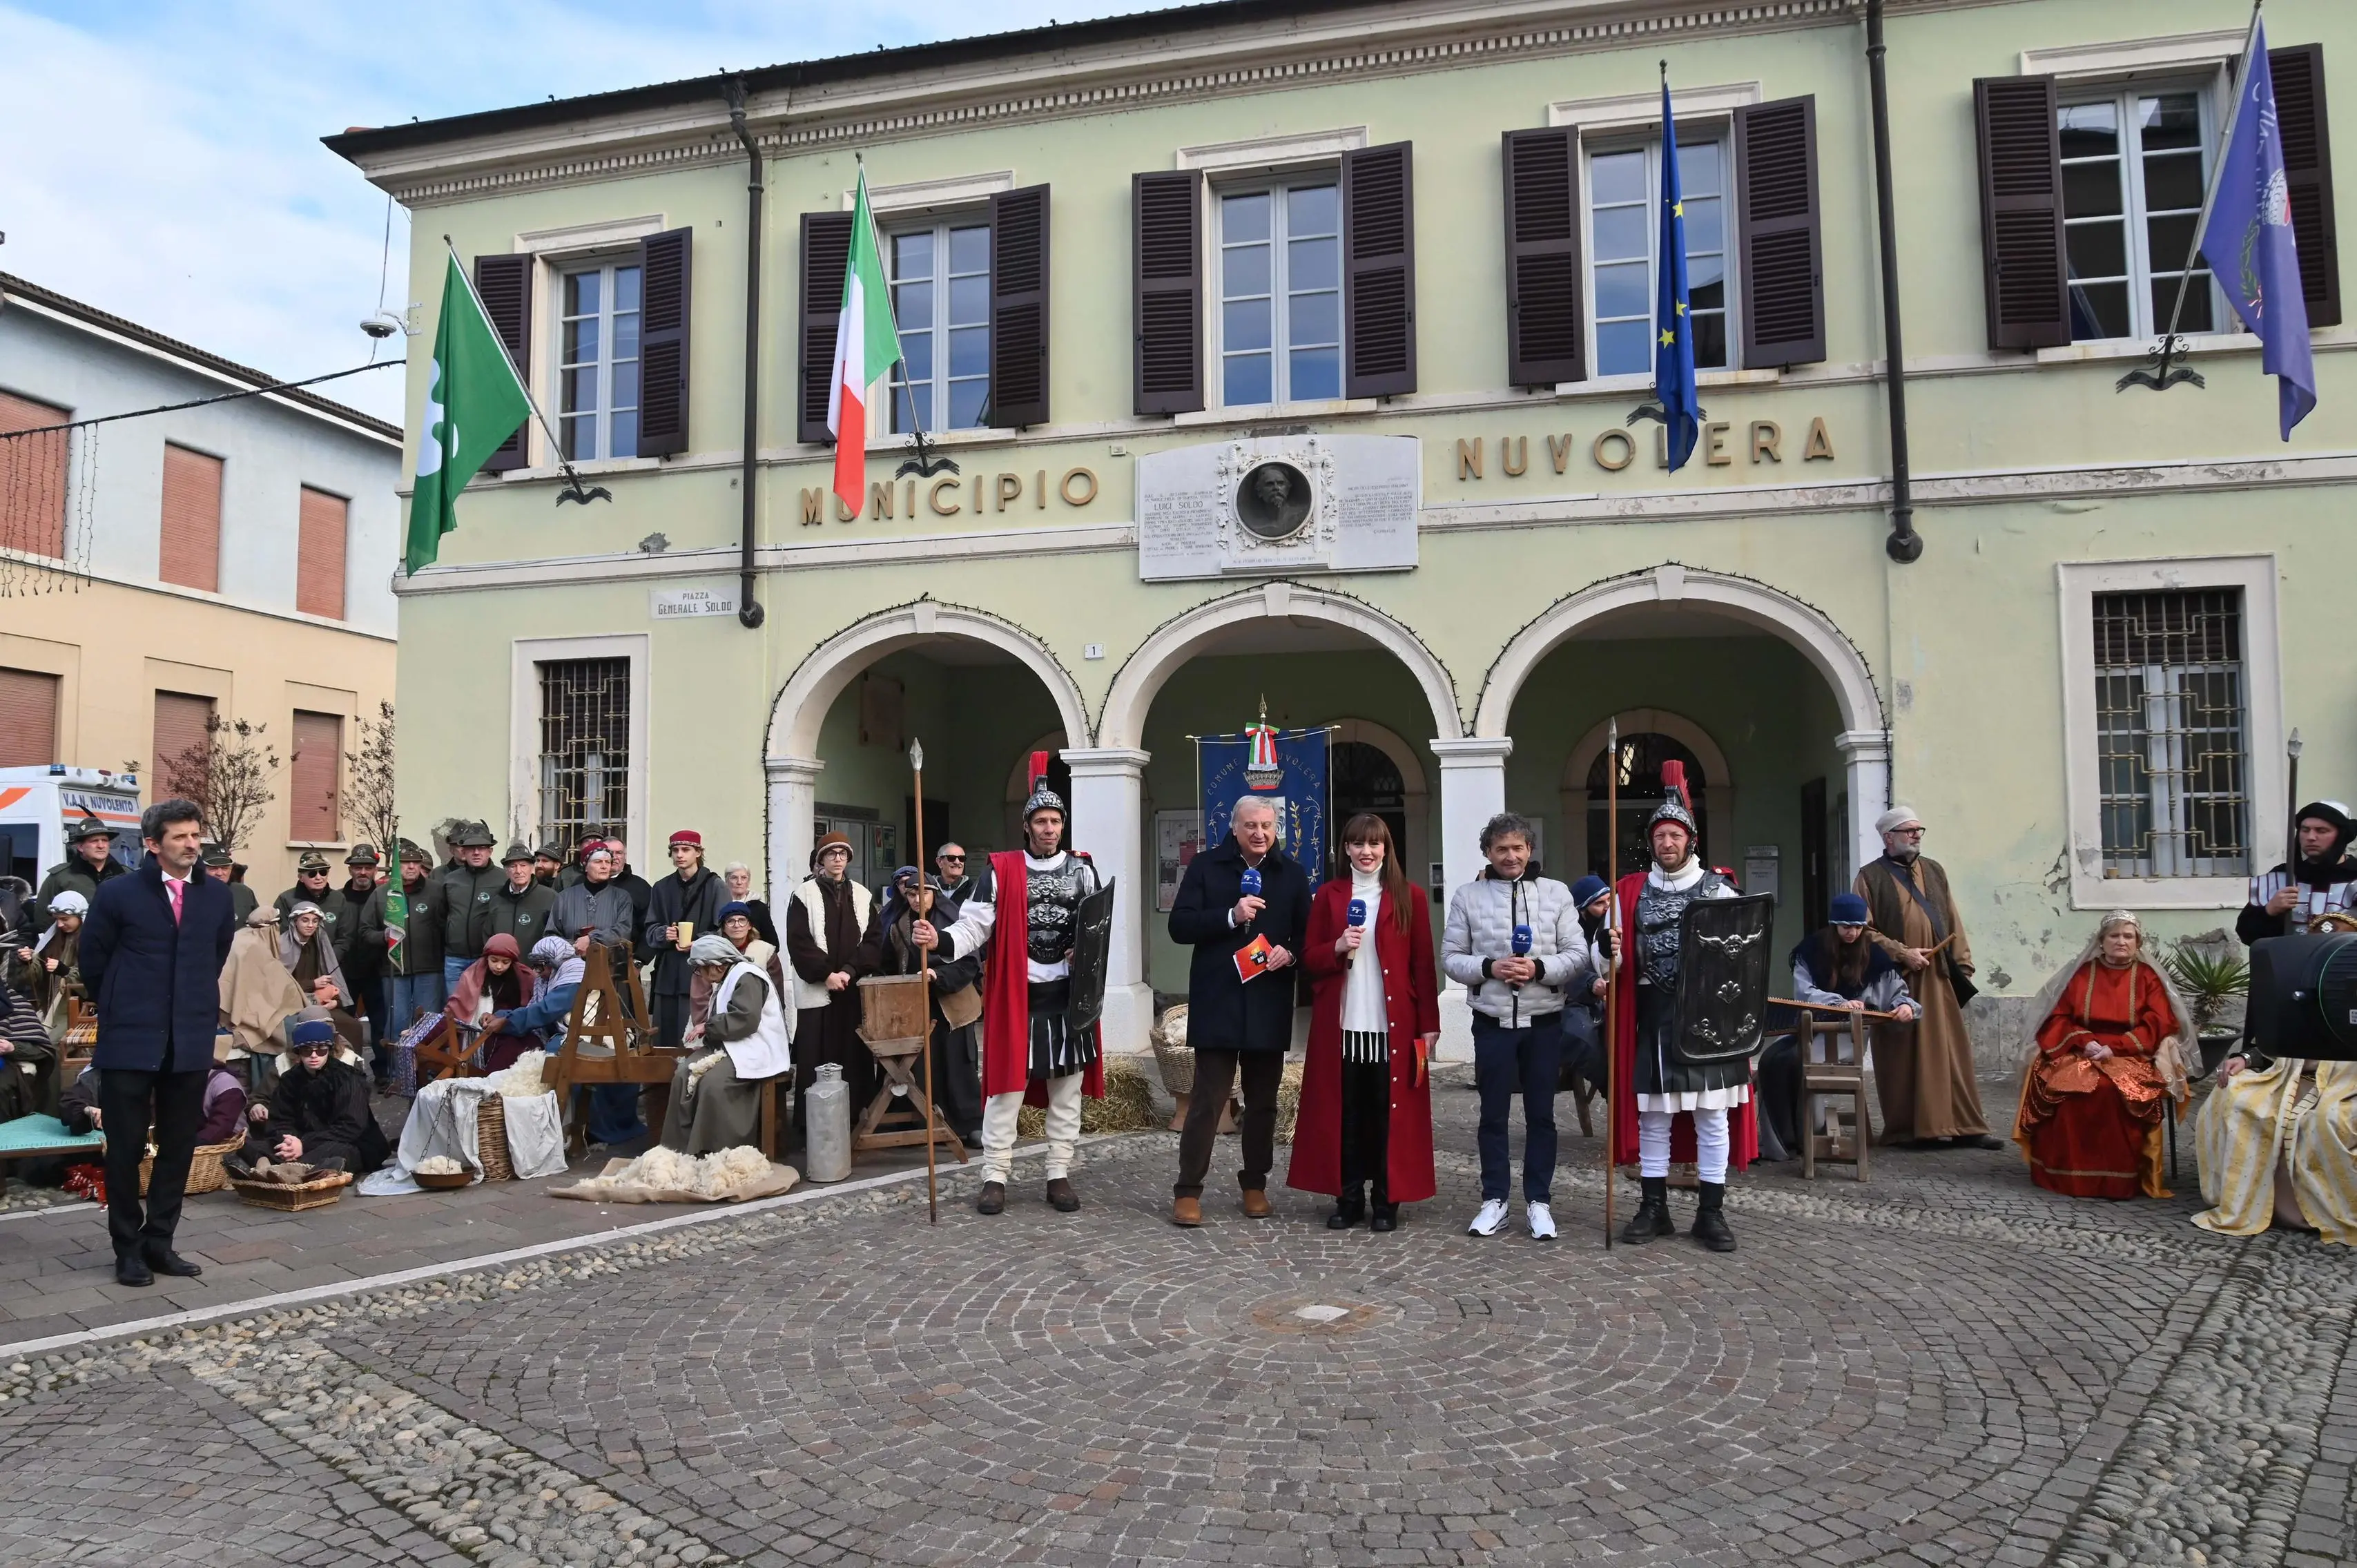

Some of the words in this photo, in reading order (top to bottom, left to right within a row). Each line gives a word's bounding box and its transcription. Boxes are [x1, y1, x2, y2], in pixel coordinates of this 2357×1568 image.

[1457, 416, 1835, 481] NUVOLERA
[1178, 501, 1203, 510] SOLDO
[682, 592, 709, 600] PIAZZA
[658, 603, 699, 615] GENERALE
[705, 601, 733, 612] SOLDO
[1092, 646, 1096, 655] 1
[1207, 757, 1240, 796] COMUNE
[90, 795, 133, 813] NUVOLENTO
